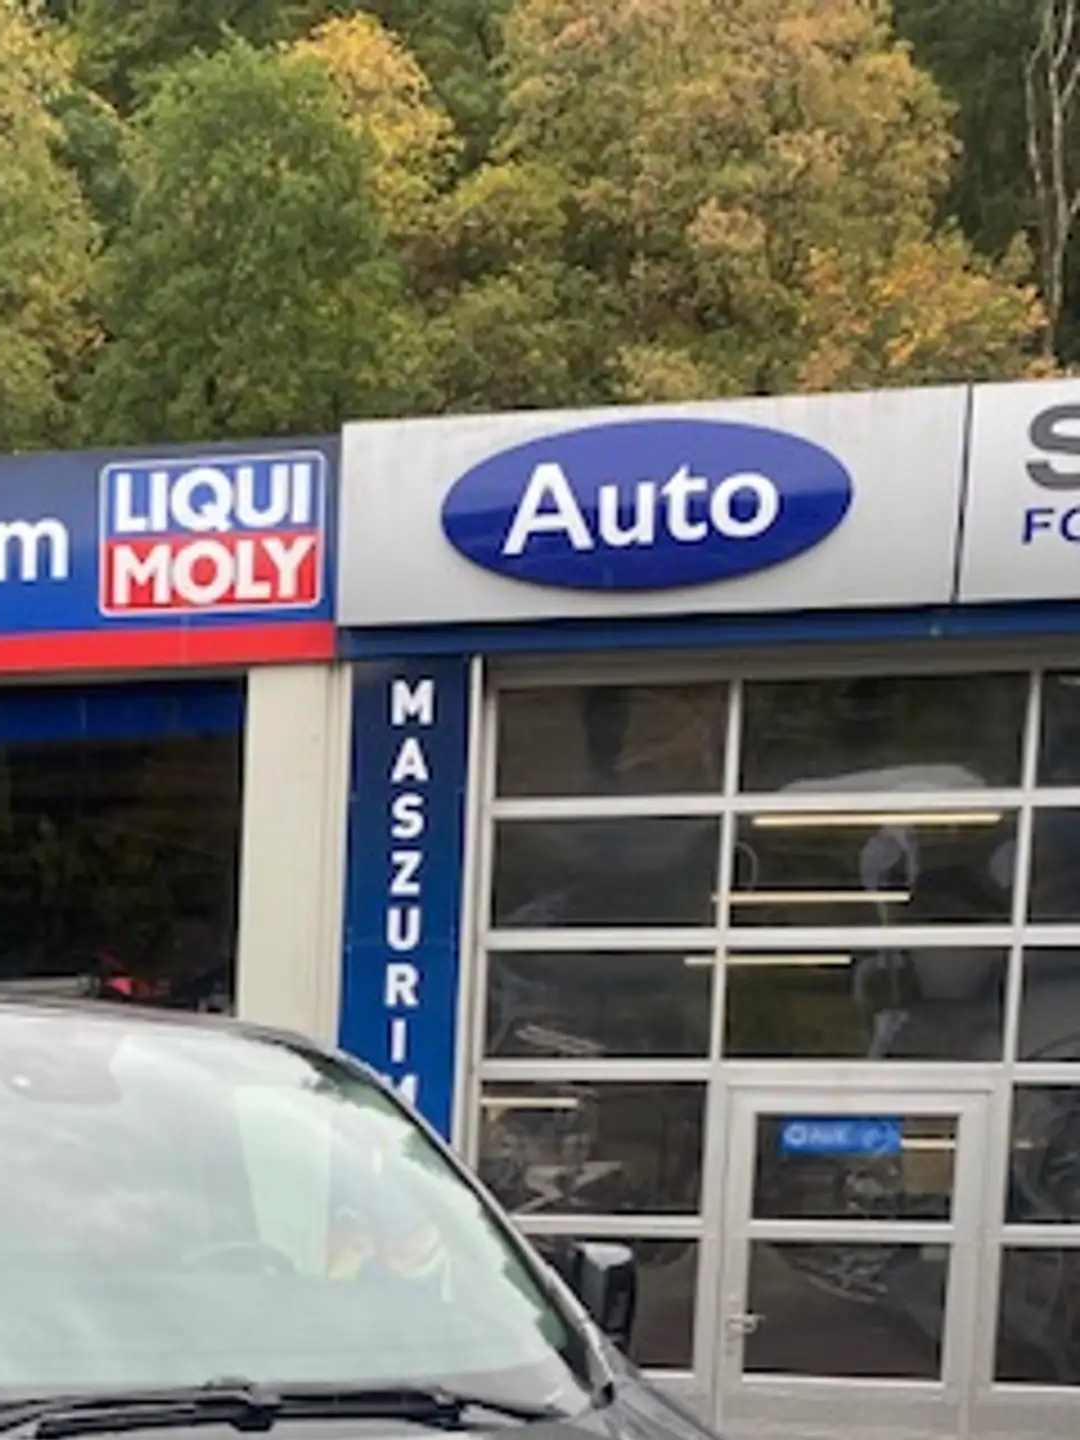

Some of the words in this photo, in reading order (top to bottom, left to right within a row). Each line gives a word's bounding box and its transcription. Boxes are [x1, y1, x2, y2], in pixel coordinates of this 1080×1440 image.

[113, 463, 312, 536] LIQUI
[500, 462, 782, 556] Auto
[111, 536, 316, 607] MOLY
